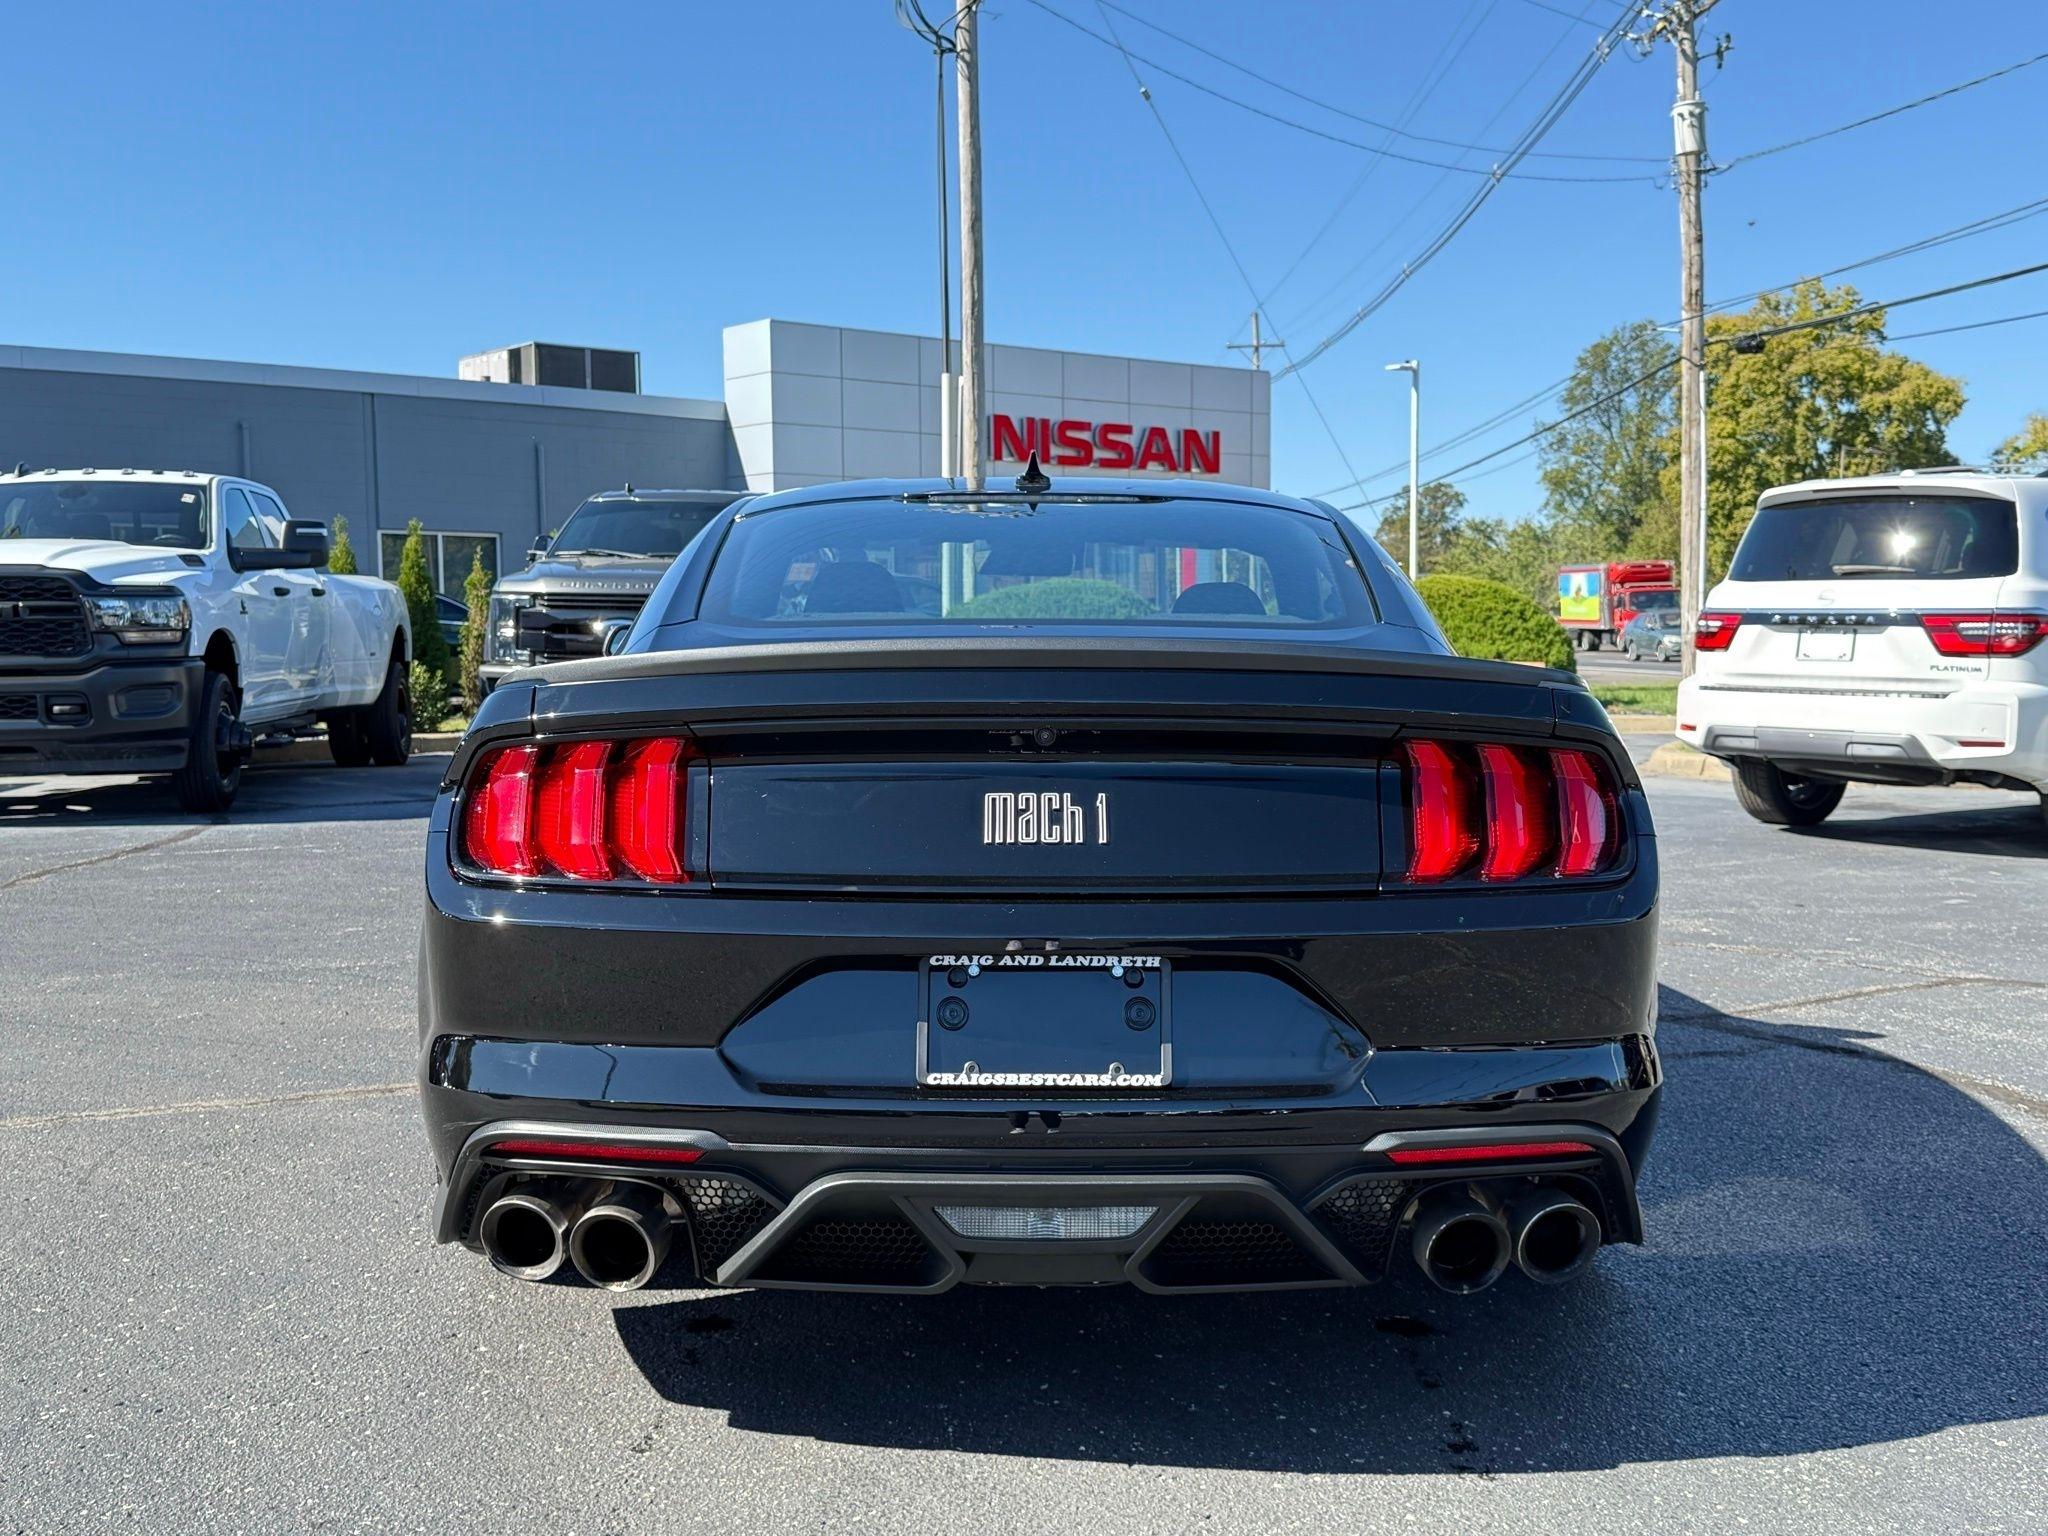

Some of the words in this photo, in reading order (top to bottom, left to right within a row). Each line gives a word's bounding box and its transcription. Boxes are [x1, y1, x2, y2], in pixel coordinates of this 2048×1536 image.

[991, 414, 1221, 475] NISSAN
[1929, 664, 1983, 673] PLATINUM
[1096, 792, 1108, 845] 1
[929, 955, 994, 967] CRAIG
[998, 955, 1045, 967] AND
[1049, 955, 1162, 968] LANDRETH
[926, 1073, 1164, 1088] CRAIGSBESTCARS.COM
